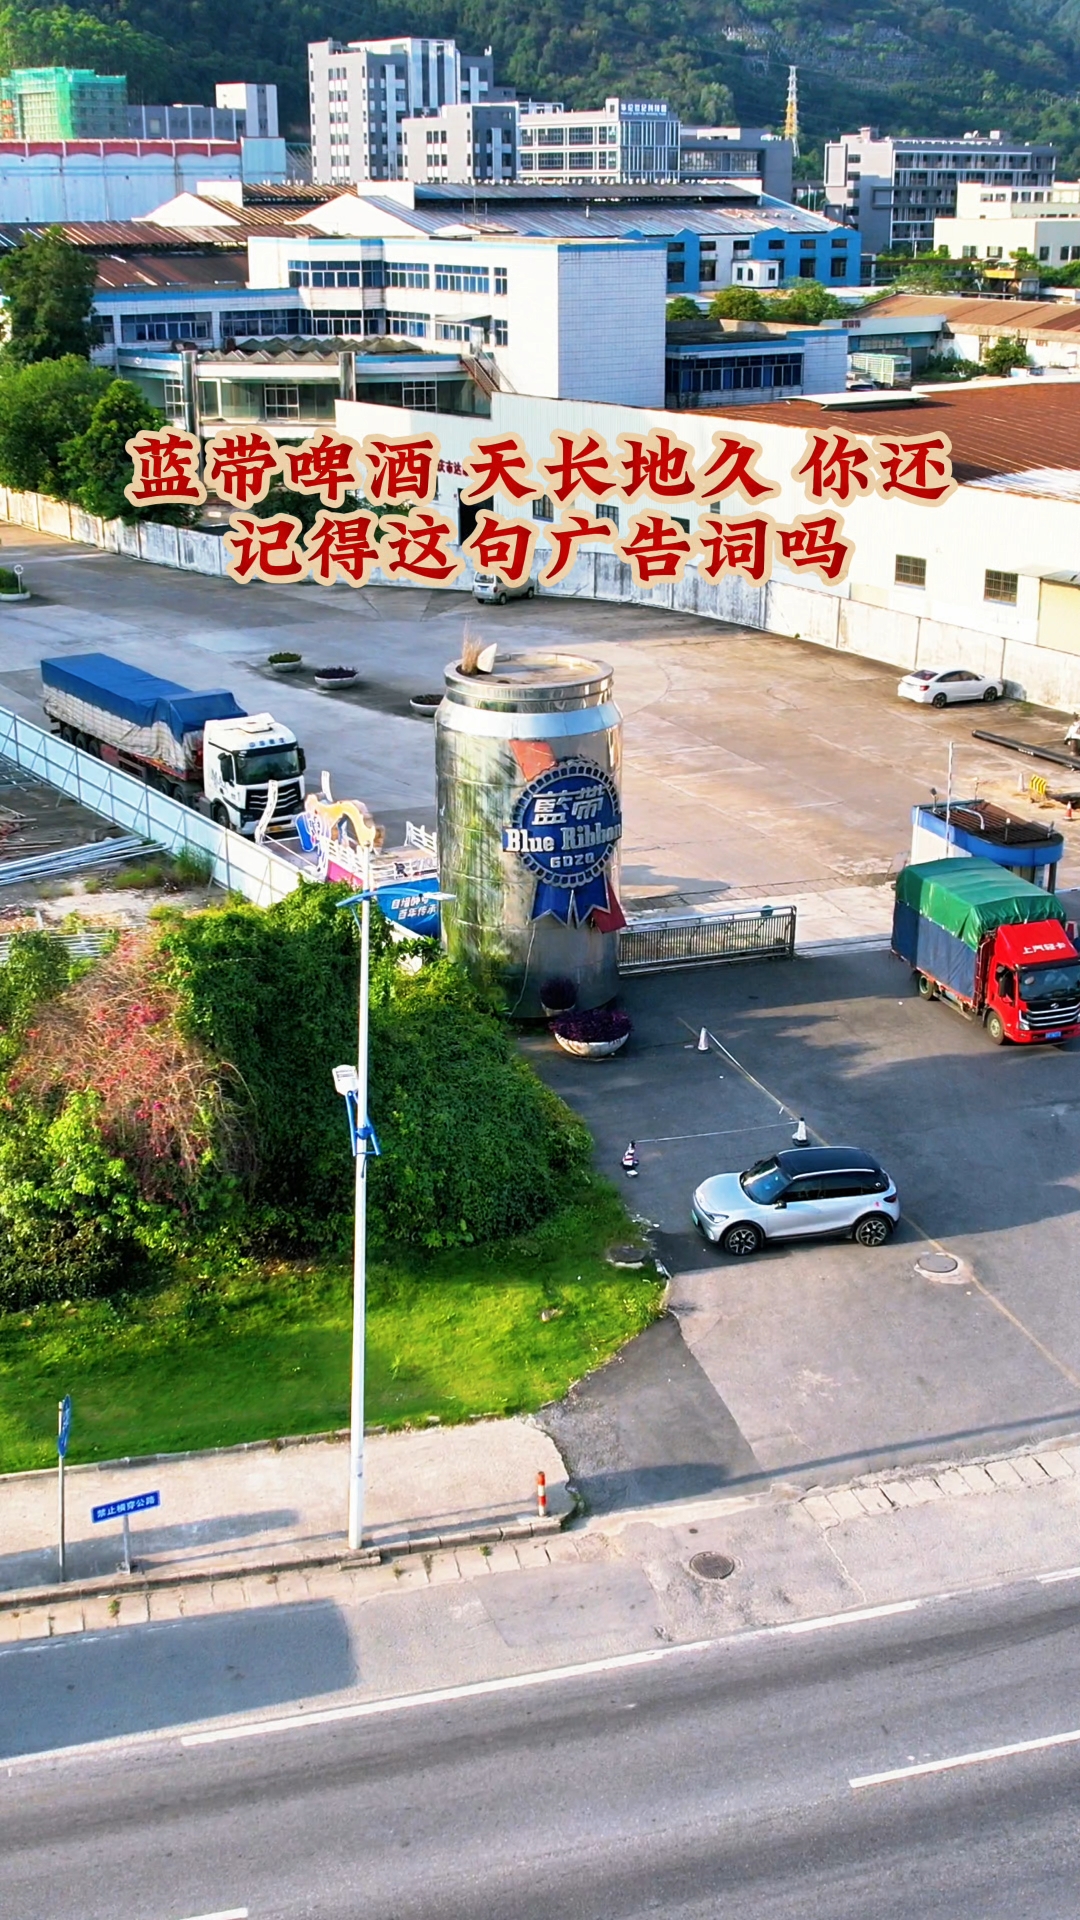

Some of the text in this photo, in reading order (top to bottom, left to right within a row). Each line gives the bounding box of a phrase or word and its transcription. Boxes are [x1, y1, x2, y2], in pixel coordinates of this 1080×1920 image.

[437, 459, 469, 476] 庆市达
[505, 822, 621, 853] Blue Ribbon
[398, 904, 437, 920] 百年传承
[1022, 942, 1066, 955] 上汽轻卡
[97, 1495, 155, 1519] 禁止横穿公路
